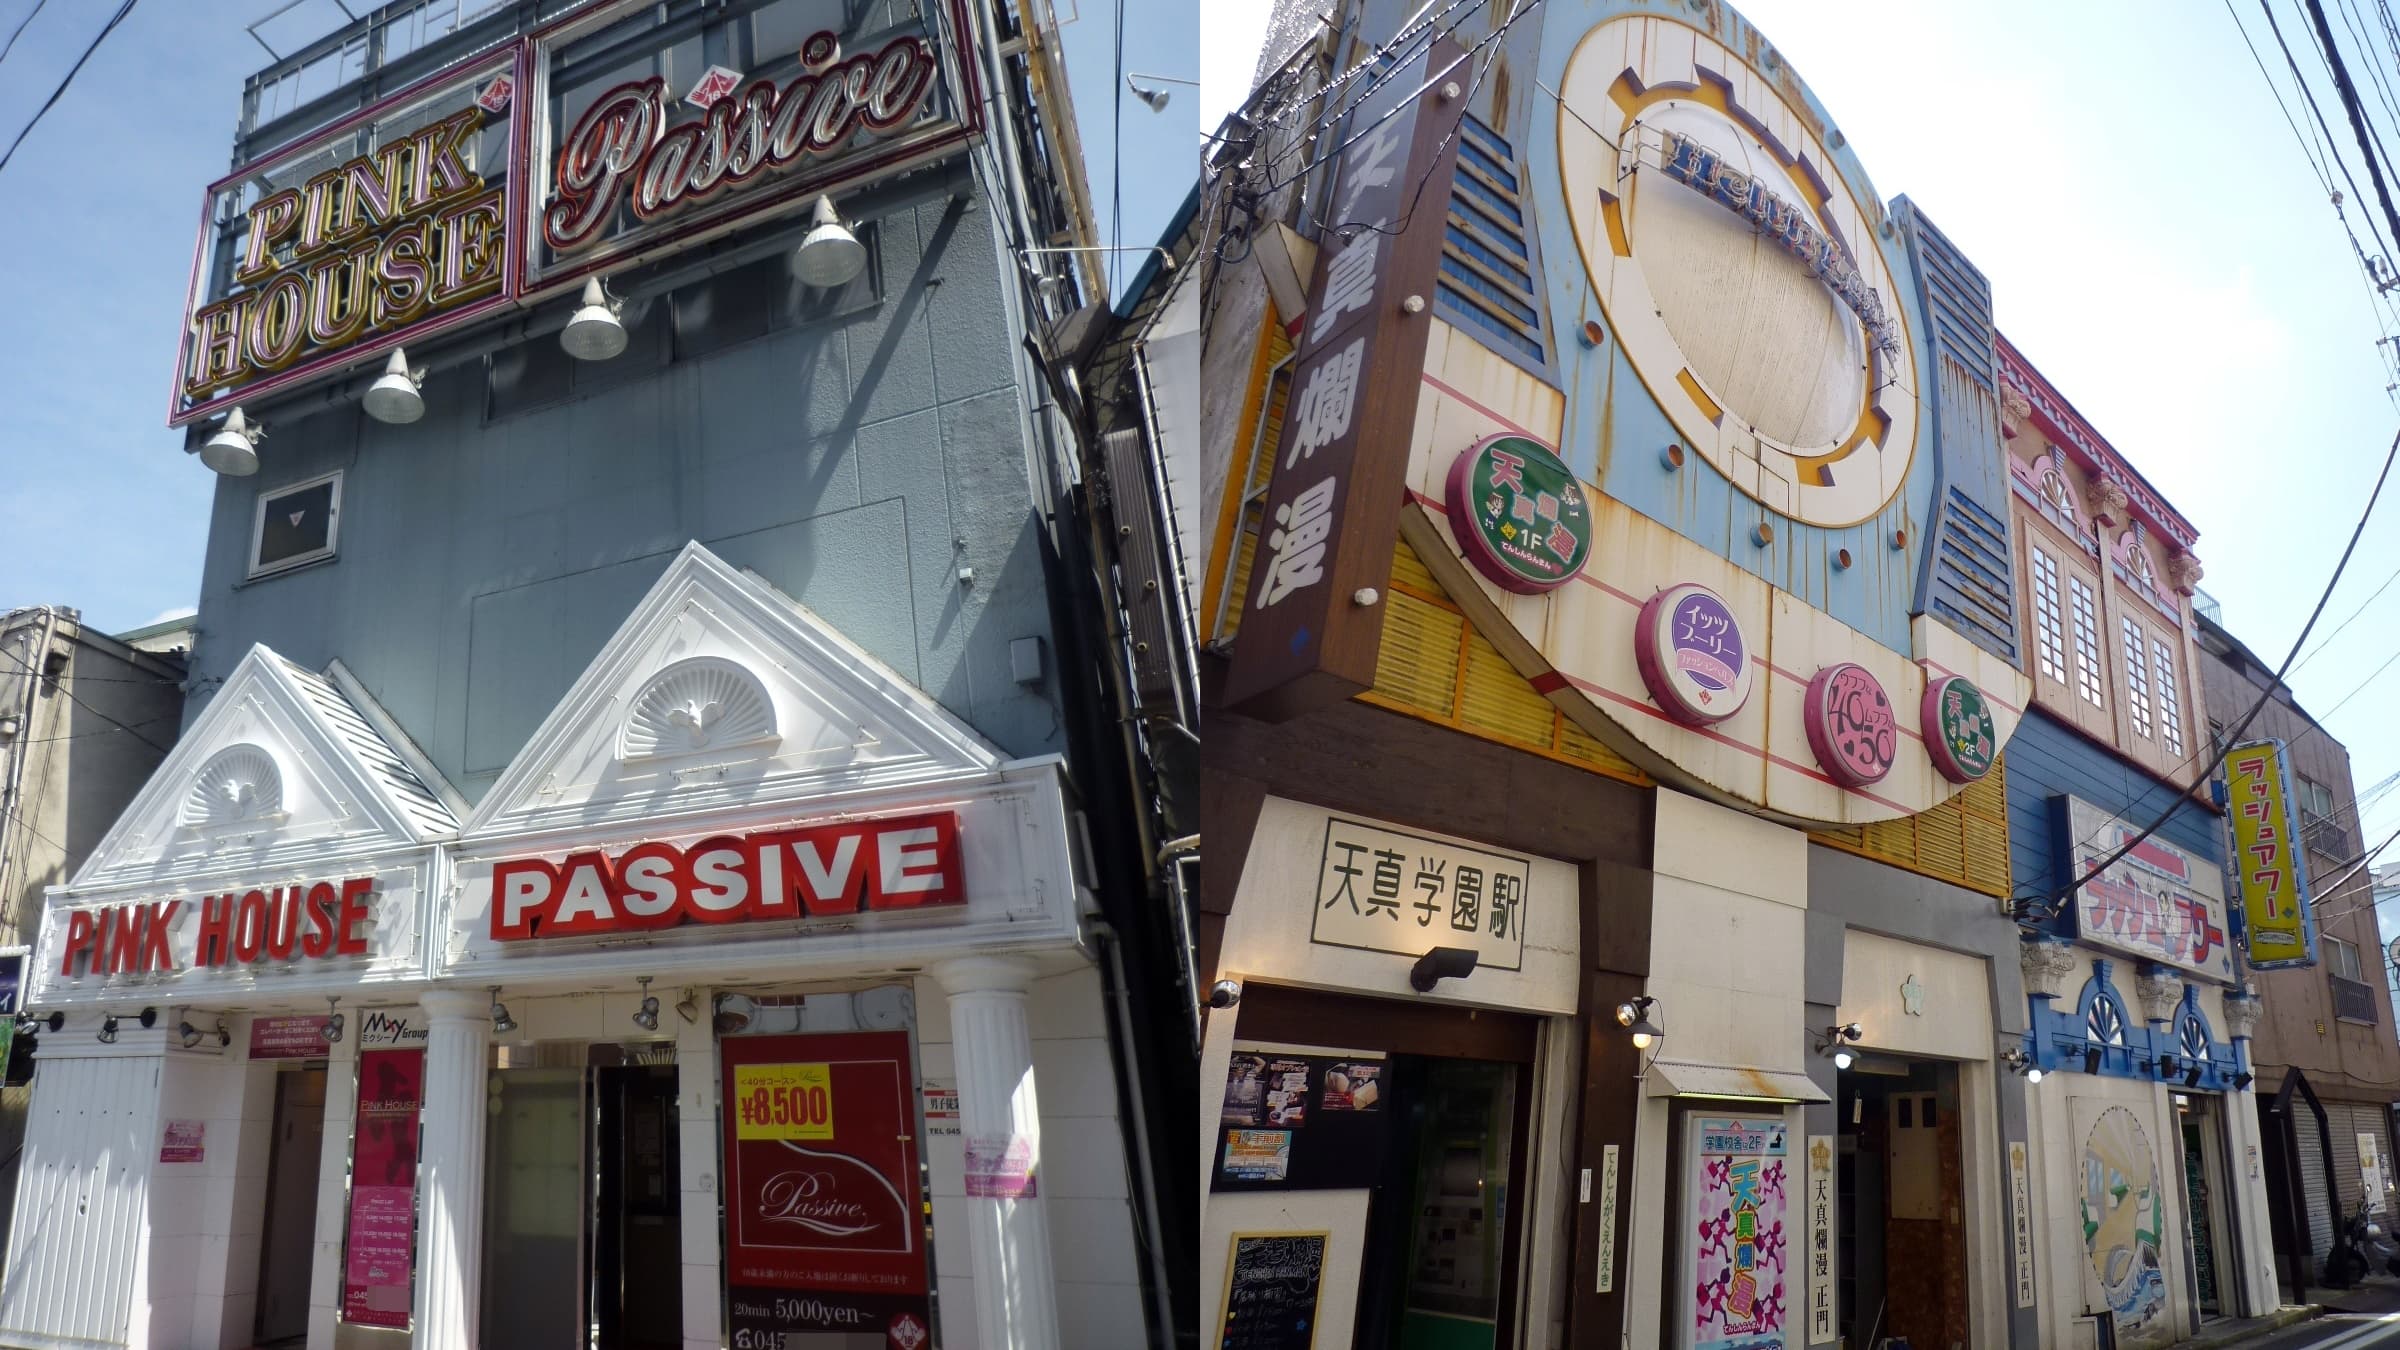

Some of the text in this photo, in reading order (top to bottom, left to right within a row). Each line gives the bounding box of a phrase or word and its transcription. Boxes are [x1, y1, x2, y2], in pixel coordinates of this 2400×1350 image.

[546, 31, 938, 254] Passive
[238, 106, 486, 282] PINK
[186, 190, 506, 400] HOUSE
[1256, 112, 1404, 610] 天真爛漫
[1521, 529, 1543, 549] 1F
[503, 826, 945, 927] PASSIVE
[2236, 756, 2281, 920] ラッシュアワー
[62, 877, 375, 977] PINK HOUSE
[1324, 840, 1521, 942] 天真学園駅
[402, 1029, 428, 1040] Group
[741, 1086, 828, 1127] ¥8,500
[759, 1170, 864, 1218] Passive
[1601, 1152, 1617, 1287] てんしんがくえんえき
[1728, 1160, 1761, 1319] 天真爛漫
[1815, 1178, 1829, 1336] 天真爛漫 正門
[2020, 1261, 2030, 1300] 正門
[735, 1302, 770, 1317] 20min
